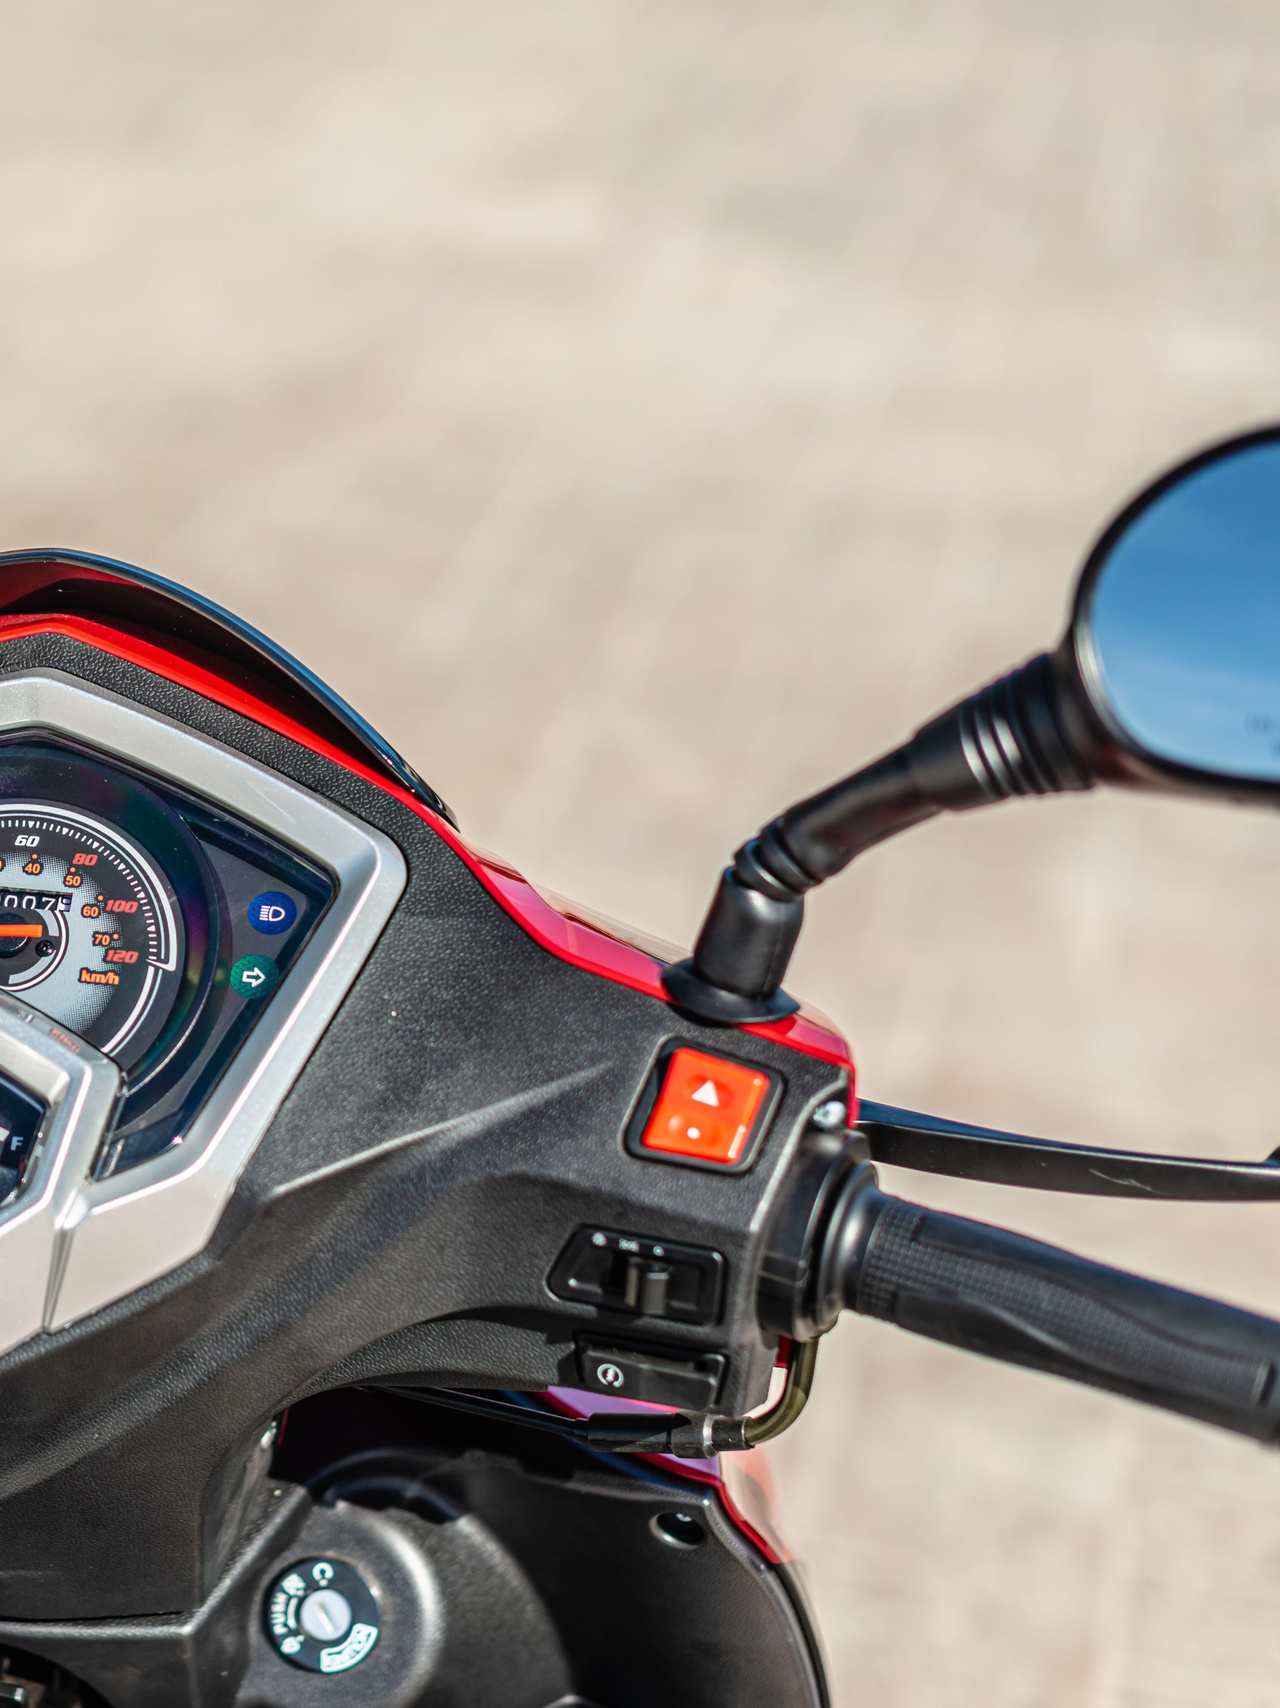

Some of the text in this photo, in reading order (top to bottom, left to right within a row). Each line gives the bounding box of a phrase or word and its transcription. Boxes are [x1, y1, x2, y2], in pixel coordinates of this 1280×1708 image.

[15, 835, 40, 848] 60
[72, 853, 98, 866] 80
[24, 862, 40, 874] 40
[65, 875, 81, 887] 50
[83, 905, 99, 917] 60
[105, 900, 138, 914] 100
[94, 933, 110, 945] 70
[106, 950, 139, 964] 120
[80, 969, 120, 986] km/h
[10, 1136, 24, 1151] F
